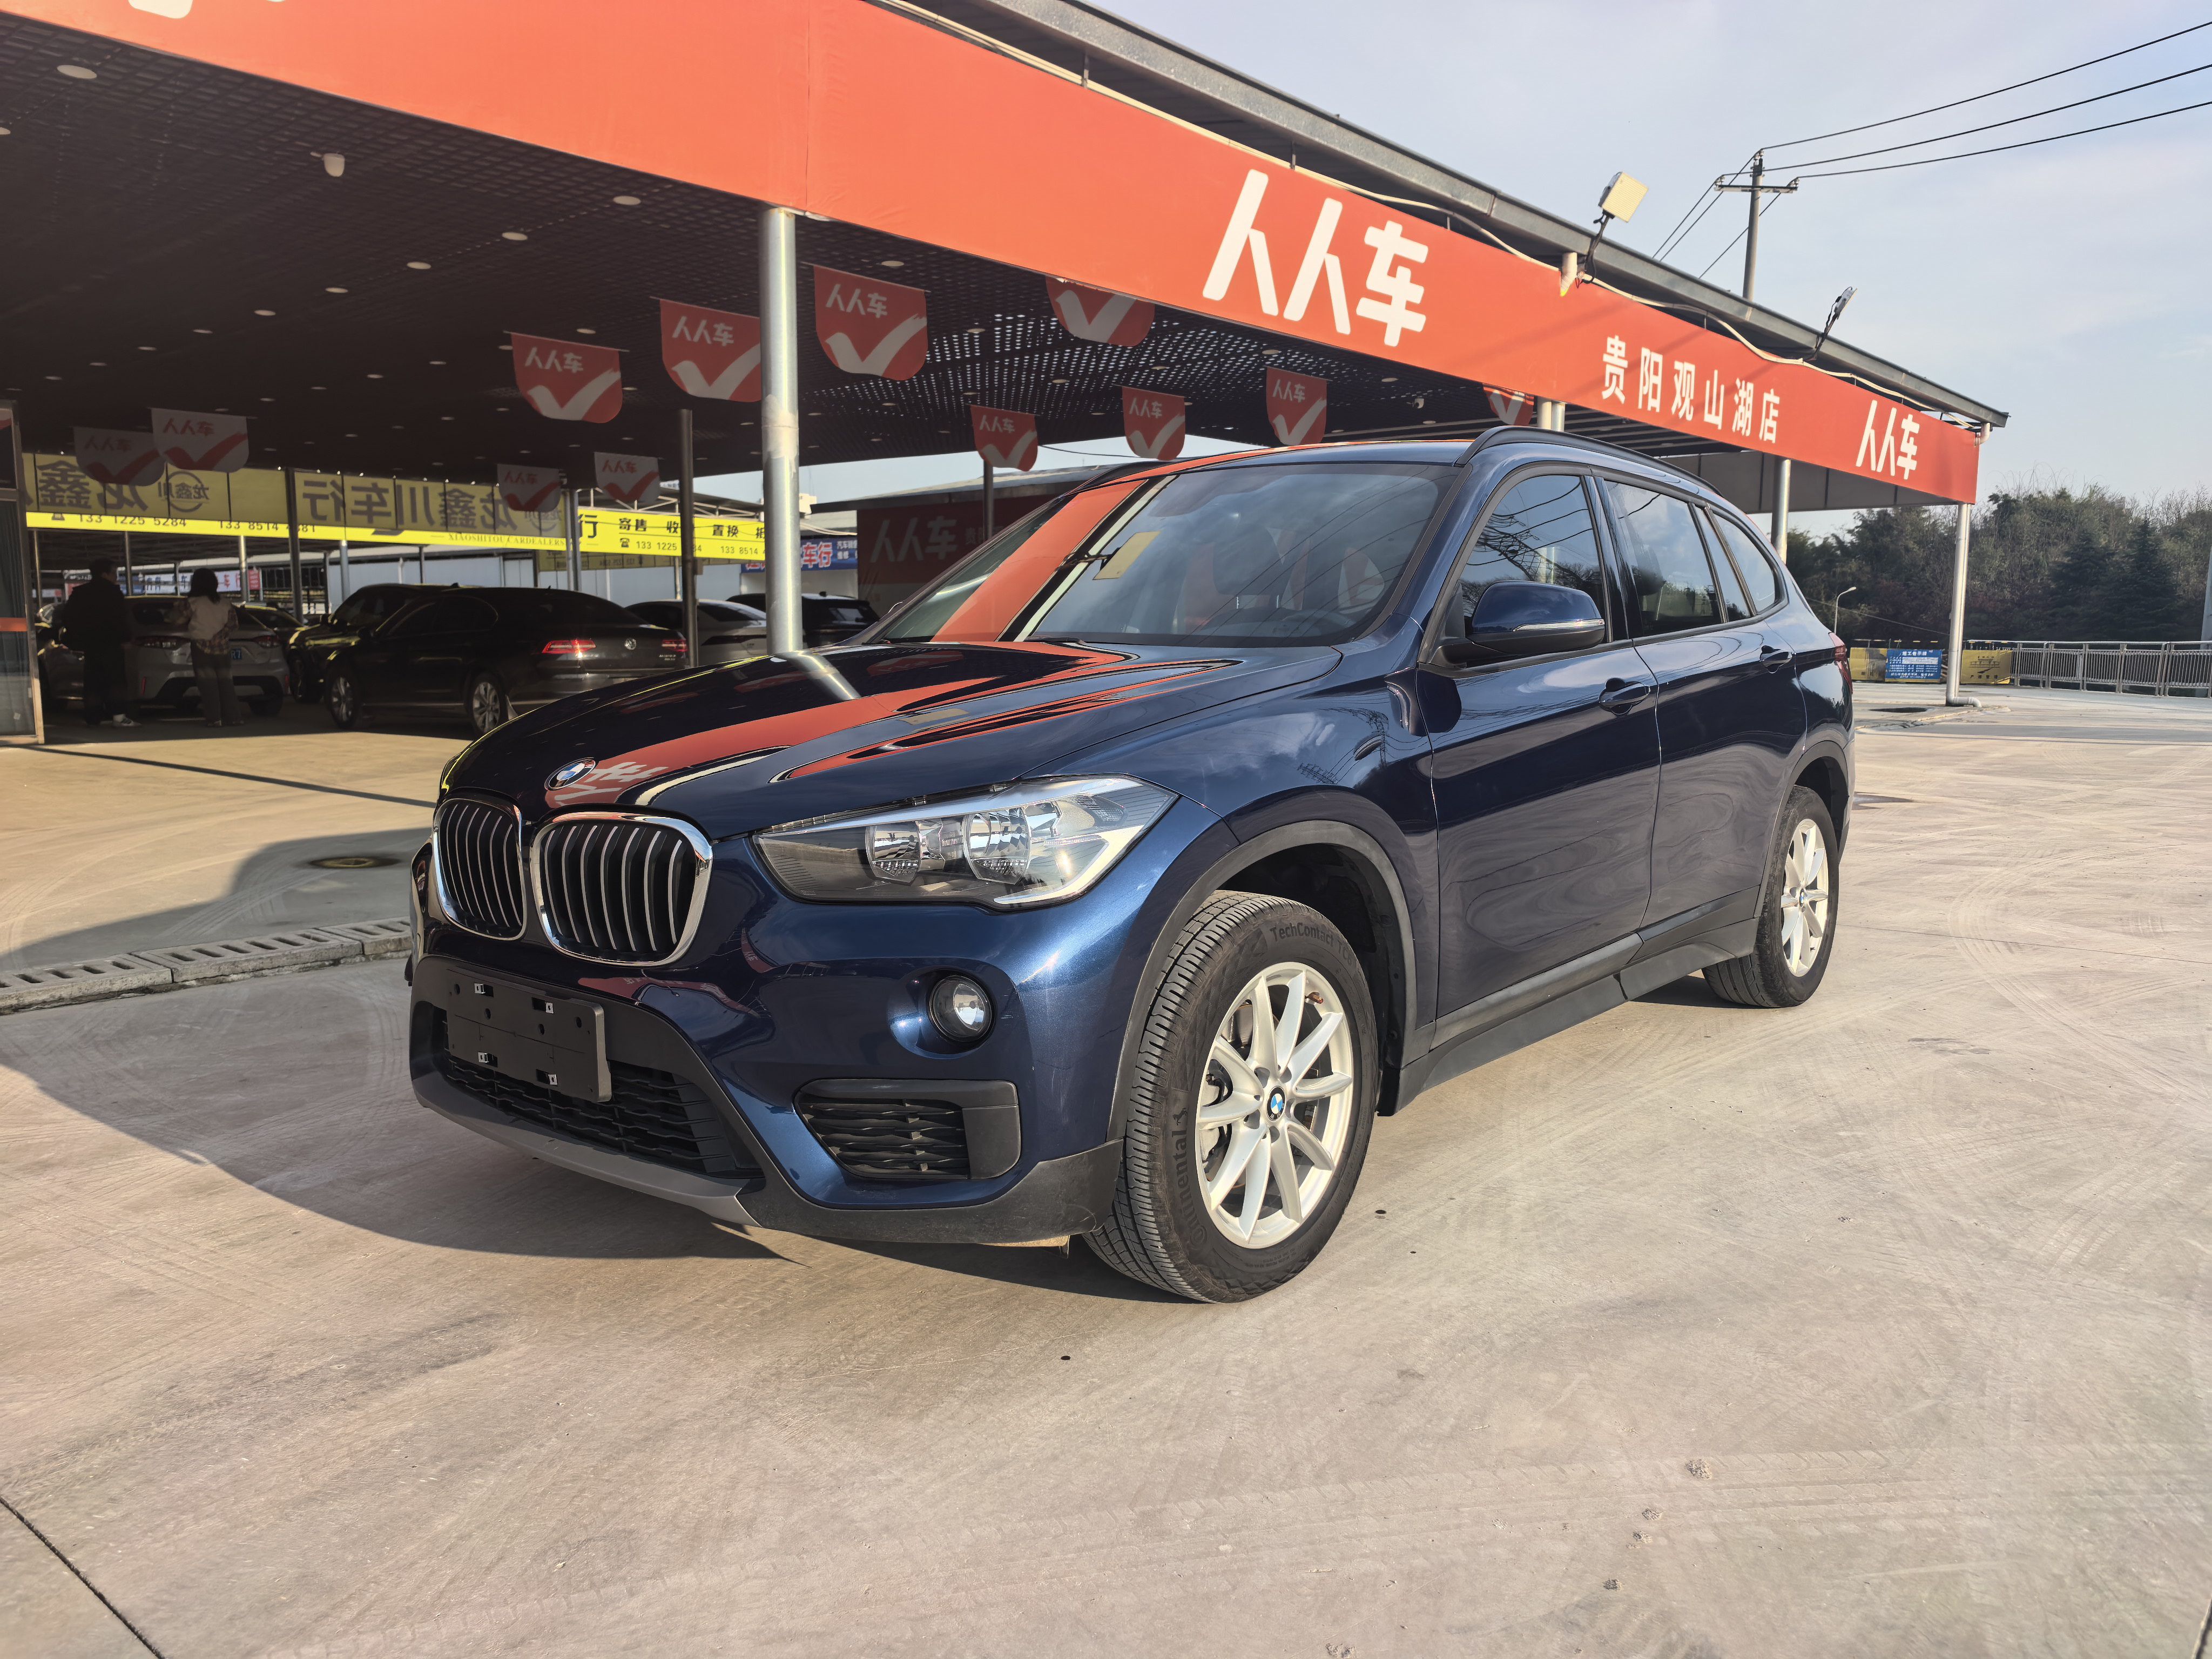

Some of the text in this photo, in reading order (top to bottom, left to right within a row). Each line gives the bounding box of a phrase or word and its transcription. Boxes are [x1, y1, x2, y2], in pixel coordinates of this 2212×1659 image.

[1202, 169, 1429, 347] 人人车
[825, 284, 888, 318] 人人车
[672, 316, 734, 346] 人人车
[525, 347, 584, 373] 人人车
[1272, 379, 1306, 402] 人人车
[1601, 335, 1781, 444] 贵阳观山湖店
[1129, 397, 1162, 419] 人人车
[163, 417, 214, 436] 人人车
[979, 415, 1015, 433] 人人车
[1856, 400, 1920, 480] 人人车
[602, 460, 637, 474] 人人车
[636, 541, 651, 549] 133
[657, 542, 677, 550] 1225
[869, 516, 958, 563] 人人车
[1269, 922, 1334, 945] TechContact
